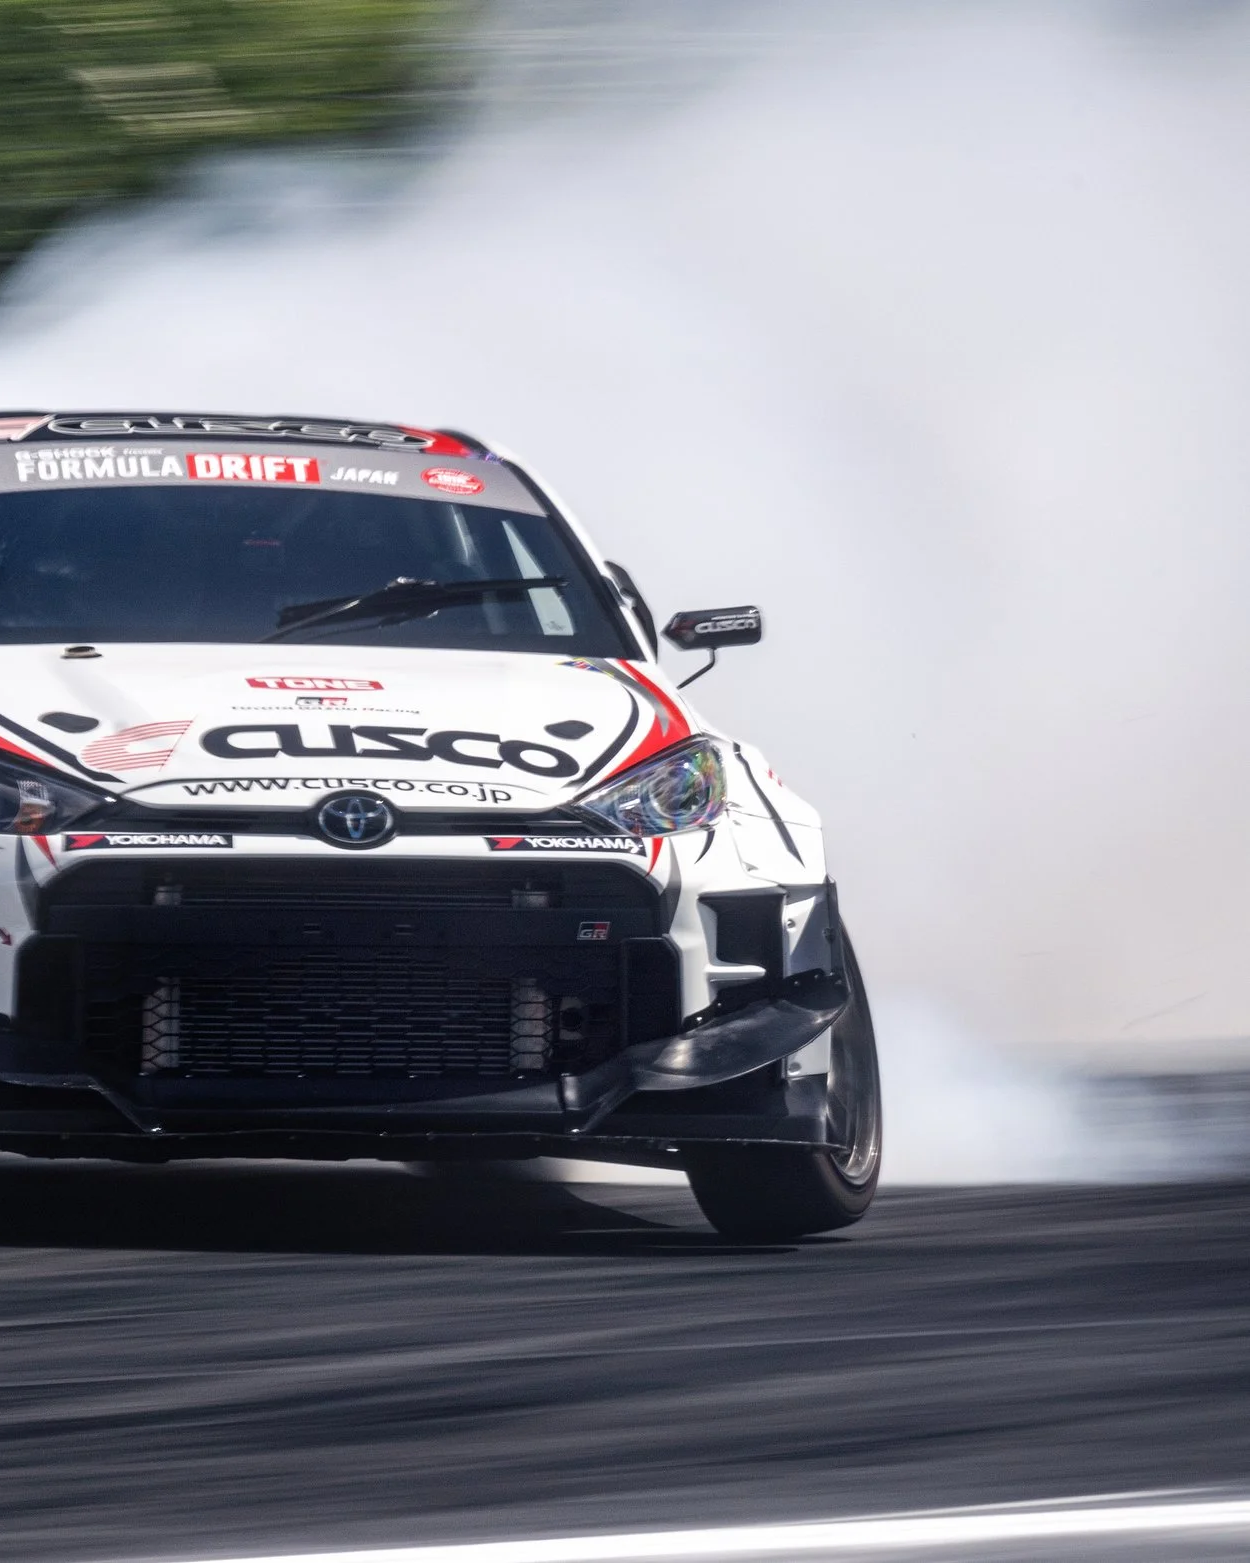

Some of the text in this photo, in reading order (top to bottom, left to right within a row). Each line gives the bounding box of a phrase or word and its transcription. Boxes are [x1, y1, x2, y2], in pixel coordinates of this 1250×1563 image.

[16, 454, 184, 482] FORMULA
[194, 454, 311, 482] DRIFT
[330, 466, 399, 485] JAPAN
[252, 677, 377, 690] TONE
[182, 777, 512, 804] www.cusco.co.jp
[105, 834, 228, 846] YOKOHAMA
[524, 837, 640, 851] YOKOHAMA
[579, 929, 607, 938] GR
